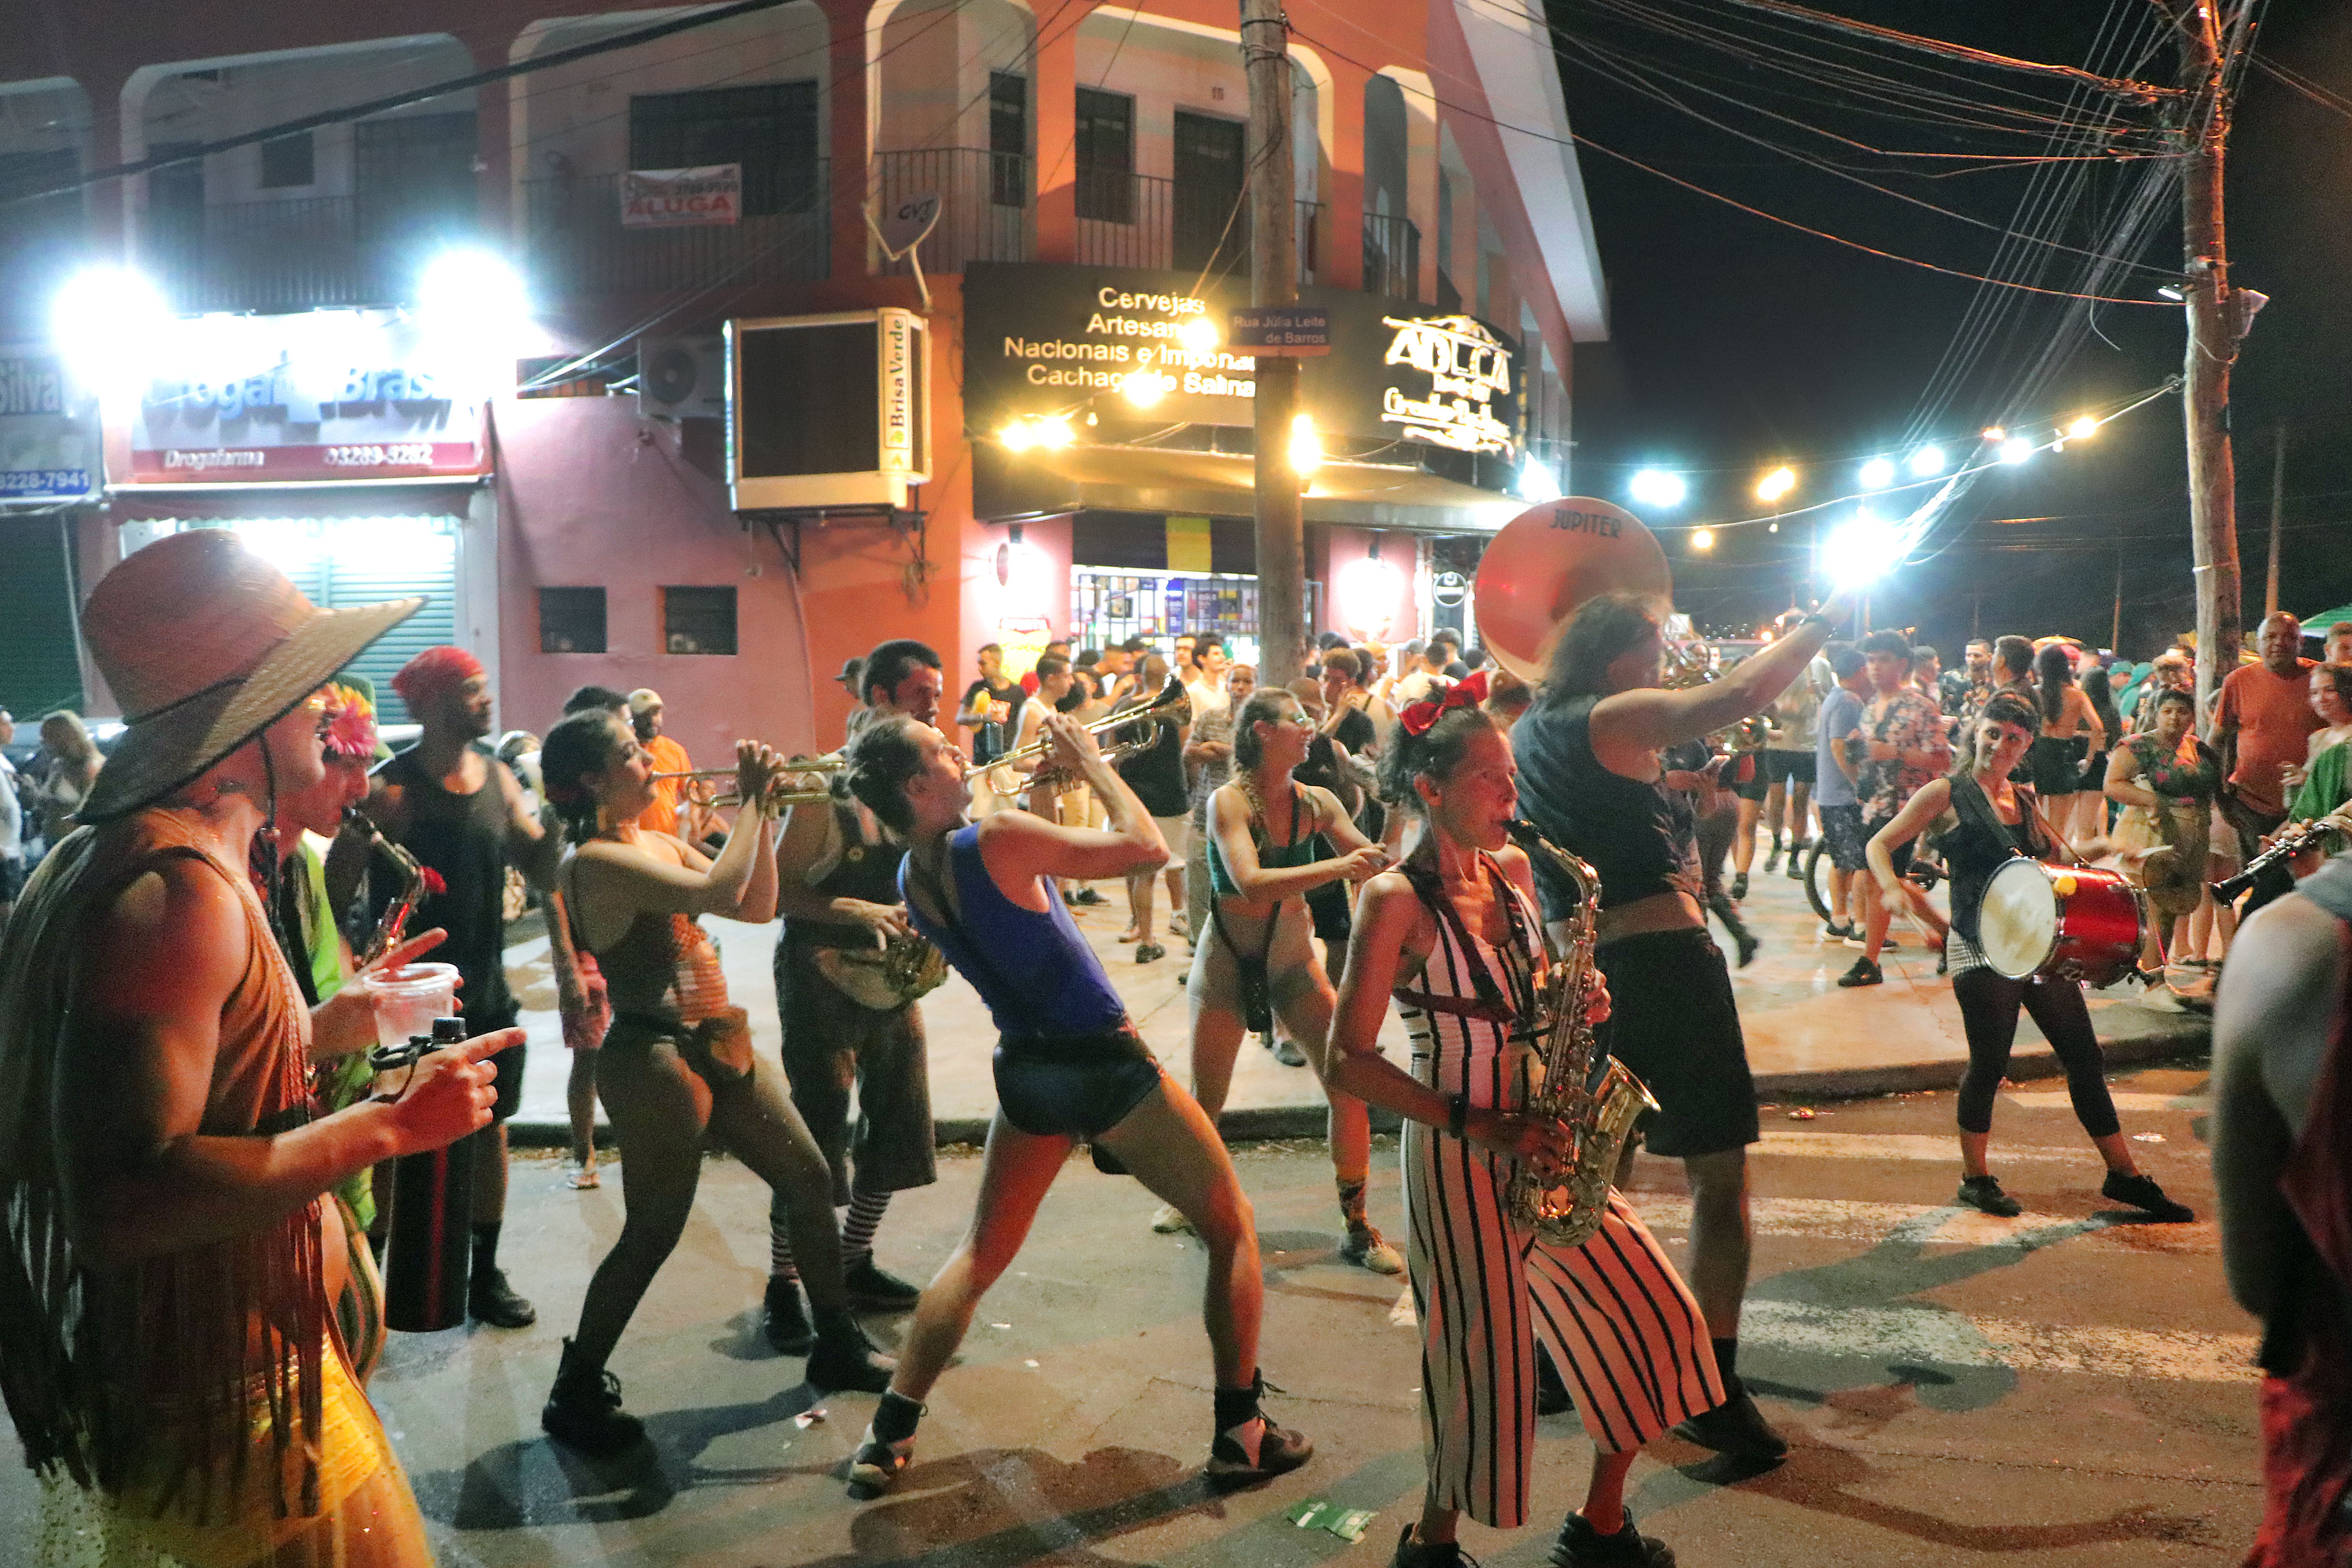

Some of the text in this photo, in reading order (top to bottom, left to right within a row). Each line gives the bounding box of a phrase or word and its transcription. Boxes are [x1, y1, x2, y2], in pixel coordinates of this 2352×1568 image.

[1099, 287, 1206, 316] Cervejas
[1234, 316, 1260, 327] Rua
[1295, 316, 1327, 327] Leite
[1004, 337, 1130, 361] Nacionais
[1136, 346, 1153, 363] e
[1265, 332, 1327, 344] de Barros
[889, 319, 904, 426] Brisa Verde
[1549, 508, 1622, 538] JUPITER
